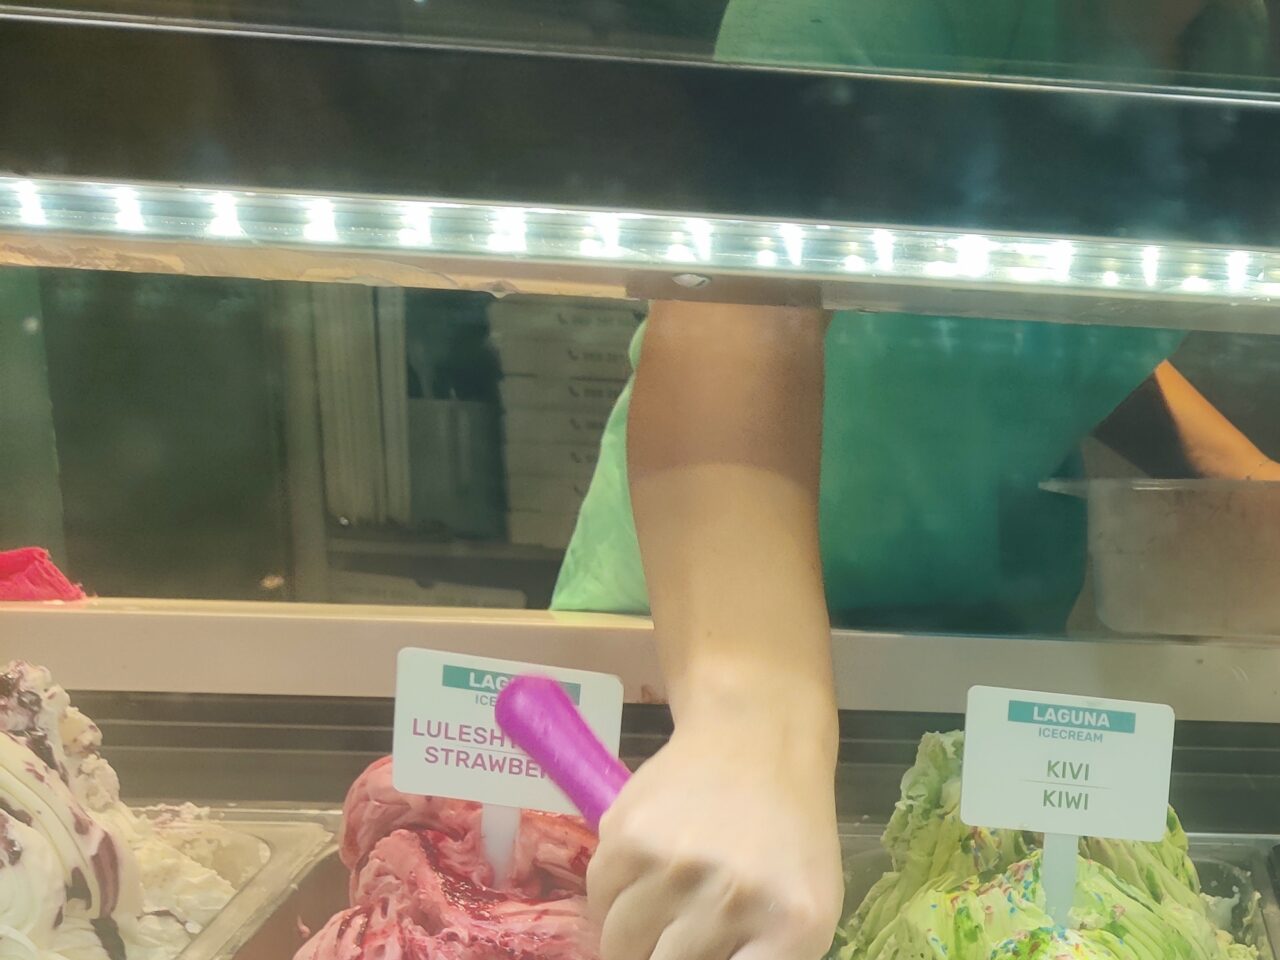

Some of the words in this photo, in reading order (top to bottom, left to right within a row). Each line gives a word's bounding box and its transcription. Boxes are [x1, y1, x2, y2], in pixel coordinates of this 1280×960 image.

[469, 672, 509, 690] LAG
[1032, 706, 1110, 728] LAGUNA
[412, 718, 516, 749] LULESH
[1038, 727, 1103, 743] ICECREAM
[424, 746, 546, 779] STRAWBE
[1047, 760, 1090, 781] KIVI
[1043, 789, 1089, 810] KIWI
